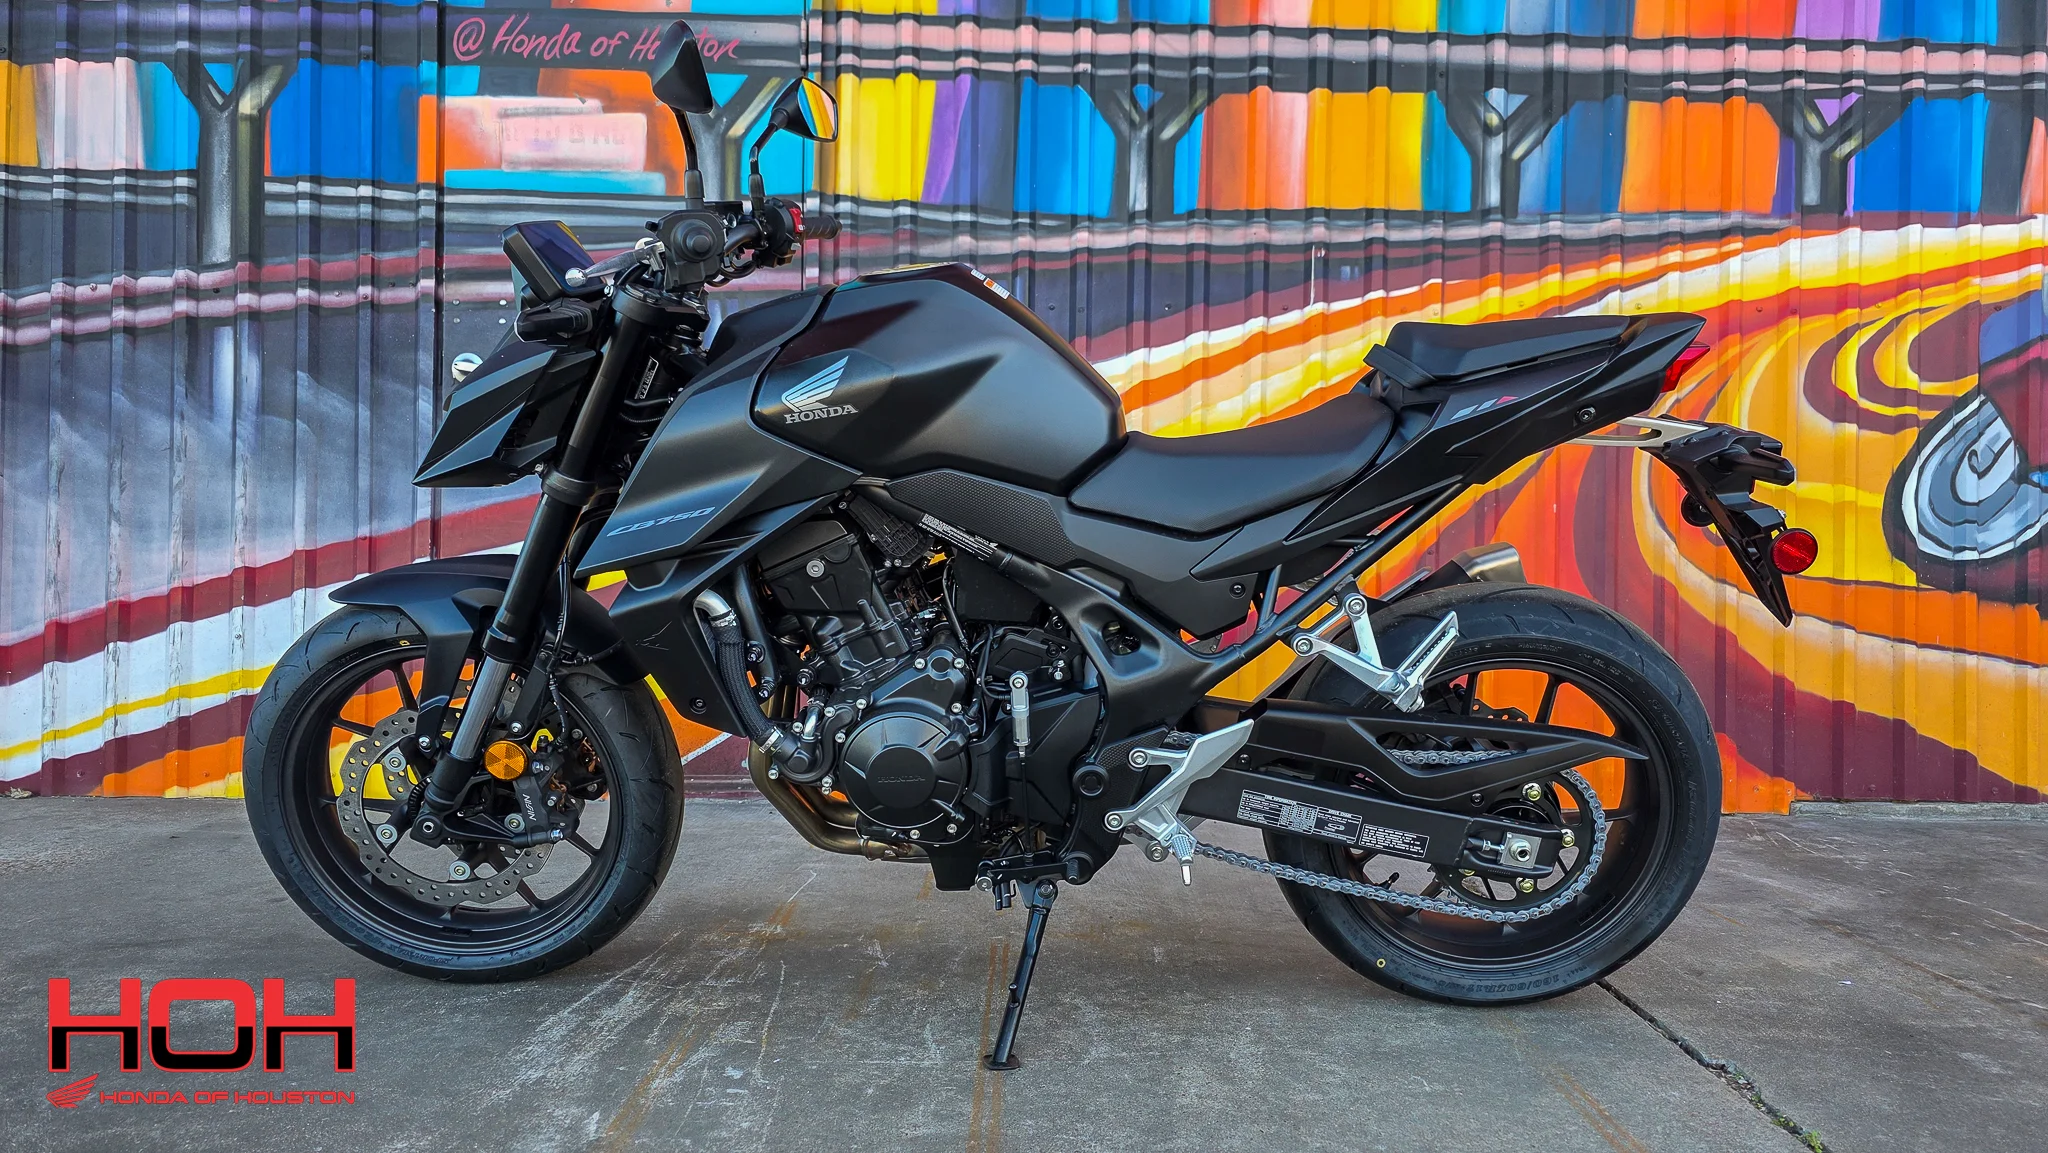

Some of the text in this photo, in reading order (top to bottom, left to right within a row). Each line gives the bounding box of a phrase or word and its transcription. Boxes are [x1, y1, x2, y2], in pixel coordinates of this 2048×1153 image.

[453, 13, 741, 62] @ Honda of Hoton
[784, 404, 859, 424] HONDA
[606, 505, 716, 538] CB750
